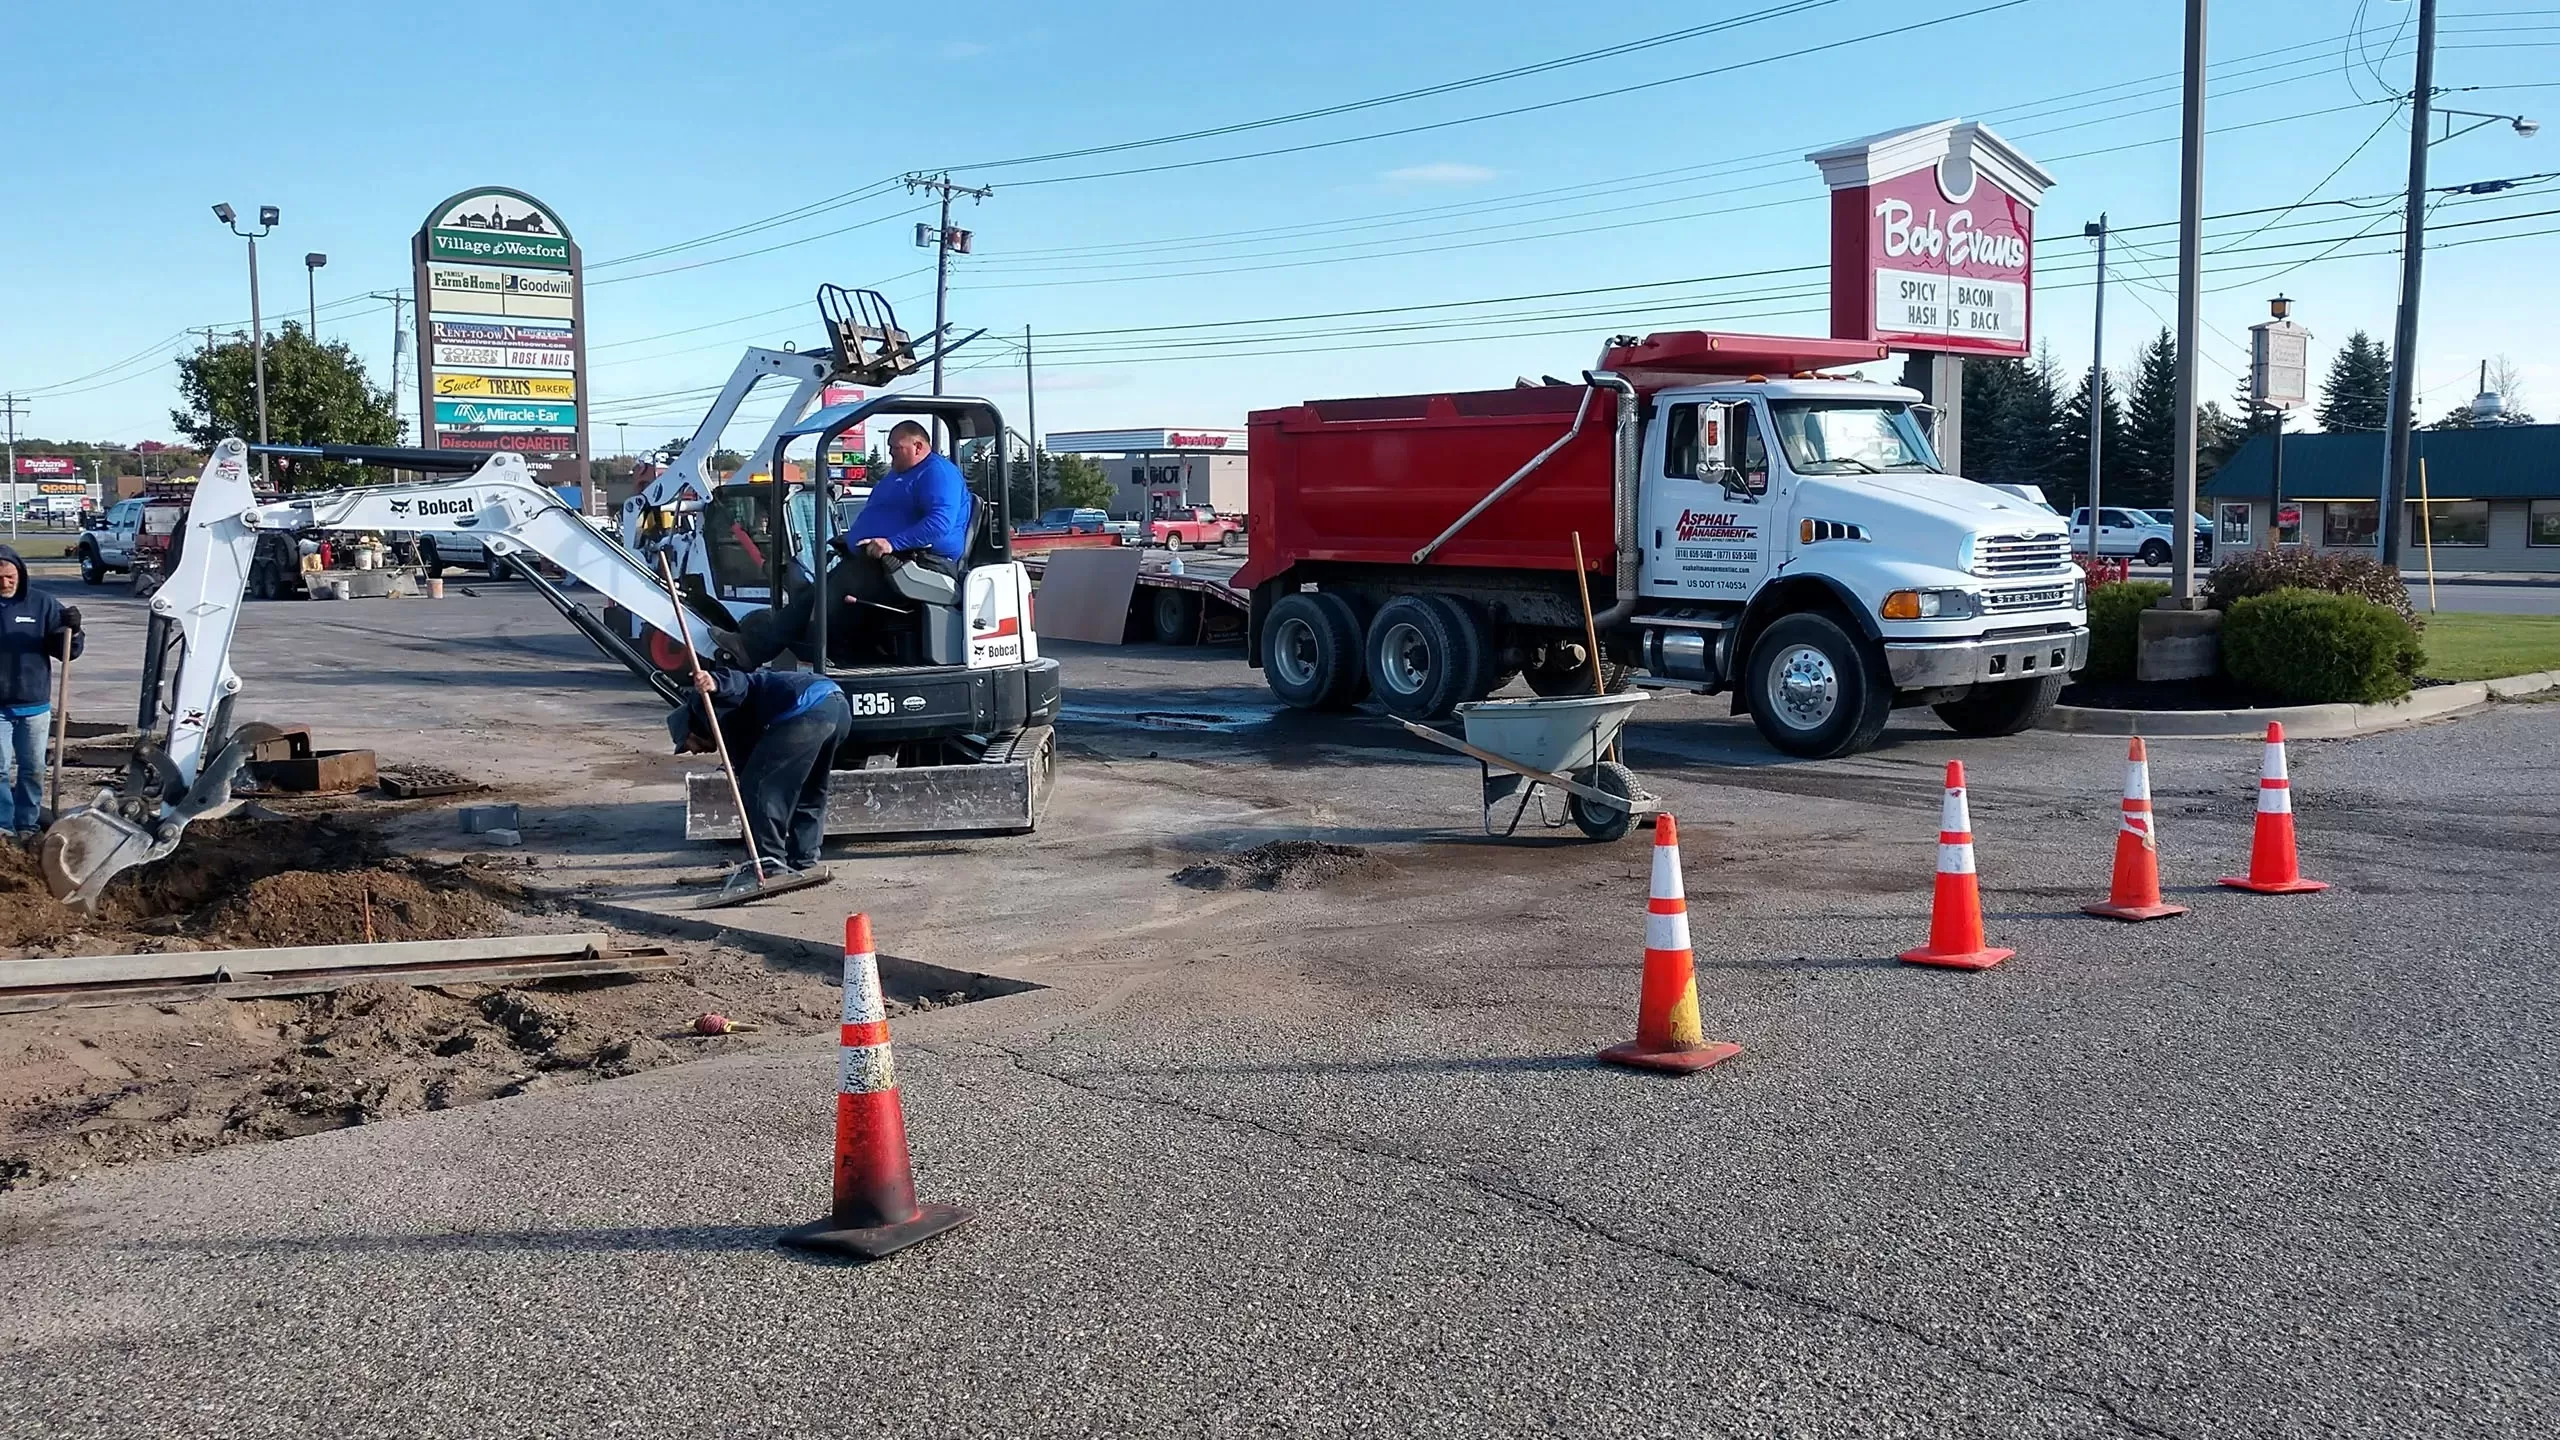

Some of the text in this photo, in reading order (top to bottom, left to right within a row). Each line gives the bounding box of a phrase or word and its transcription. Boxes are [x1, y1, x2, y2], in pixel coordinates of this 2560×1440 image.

[1875, 198, 2025, 268] Bob Evans
[436, 236, 491, 254] Village
[504, 242, 567, 258] Wexford
[443, 270, 464, 278] FAMILY
[519, 278, 571, 294] Goodwill
[1900, 280, 1993, 307] SPICY BACON
[1908, 305, 2000, 330] HASH IS BACK
[441, 347, 498, 357] GOLDEN
[512, 352, 570, 366] ROSE NAILS
[441, 377, 569, 395] Sweet TREATS BAKERY
[441, 436, 569, 451] Discount CIGARETTE
[1781, 487, 1787, 496] 4
[418, 497, 474, 516] Bobcat
[1675, 509, 1738, 531] ASPHALT
[1678, 526, 1749, 541] MANAGEMENT
[1687, 580, 1747, 590] US DOT 1740534
[1997, 591, 2060, 603] STERLING
[988, 643, 1018, 658] Bobcat
[852, 692, 895, 716] E35i
